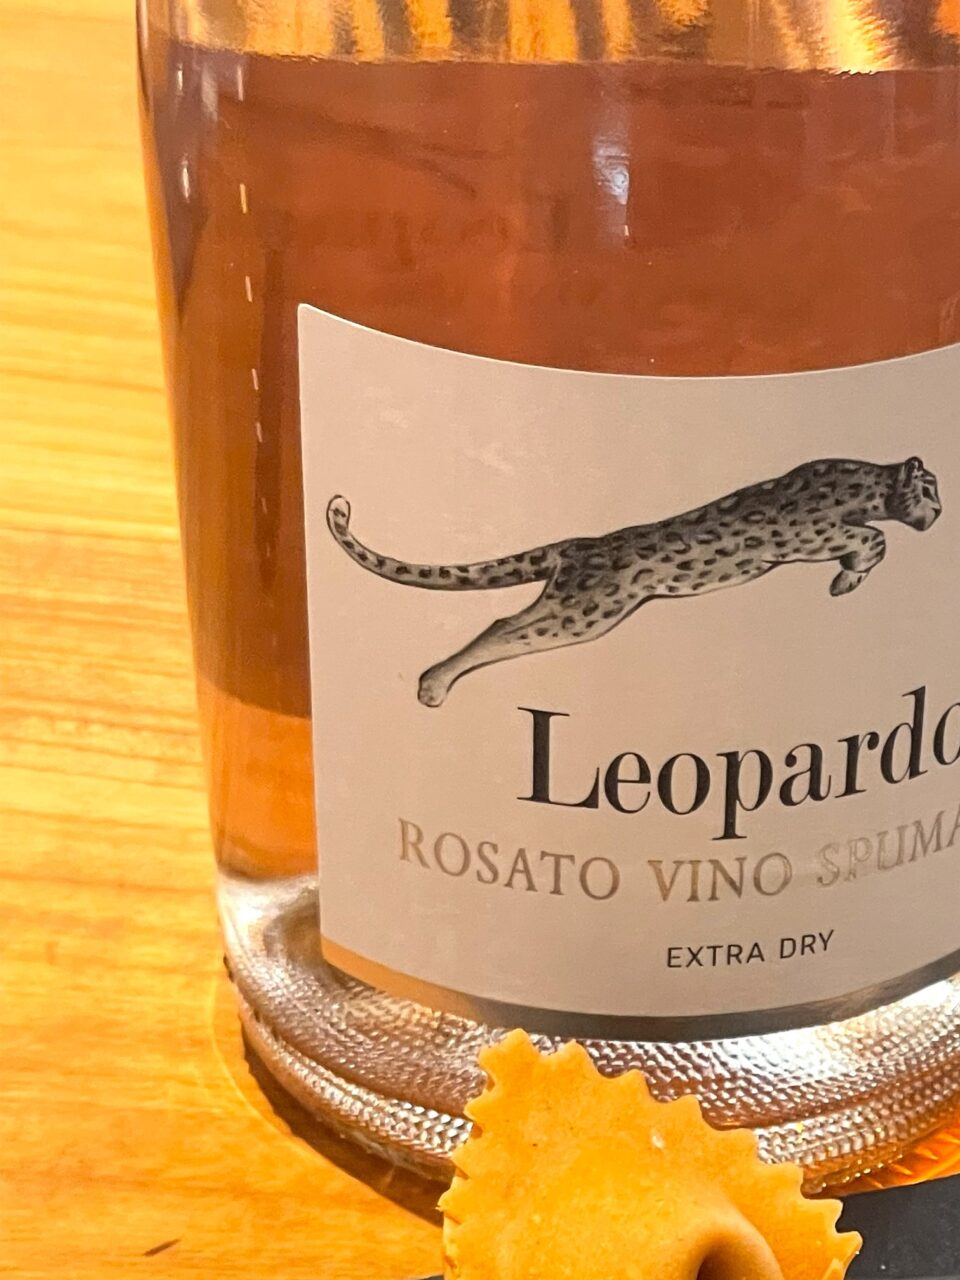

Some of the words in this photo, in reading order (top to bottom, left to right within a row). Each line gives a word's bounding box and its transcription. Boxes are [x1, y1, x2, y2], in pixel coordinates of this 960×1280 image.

[398, 816, 621, 901] ROSATO
[647, 851, 794, 903] VINO
[666, 943, 766, 969] EXTRA
[779, 929, 836, 961] DRY
